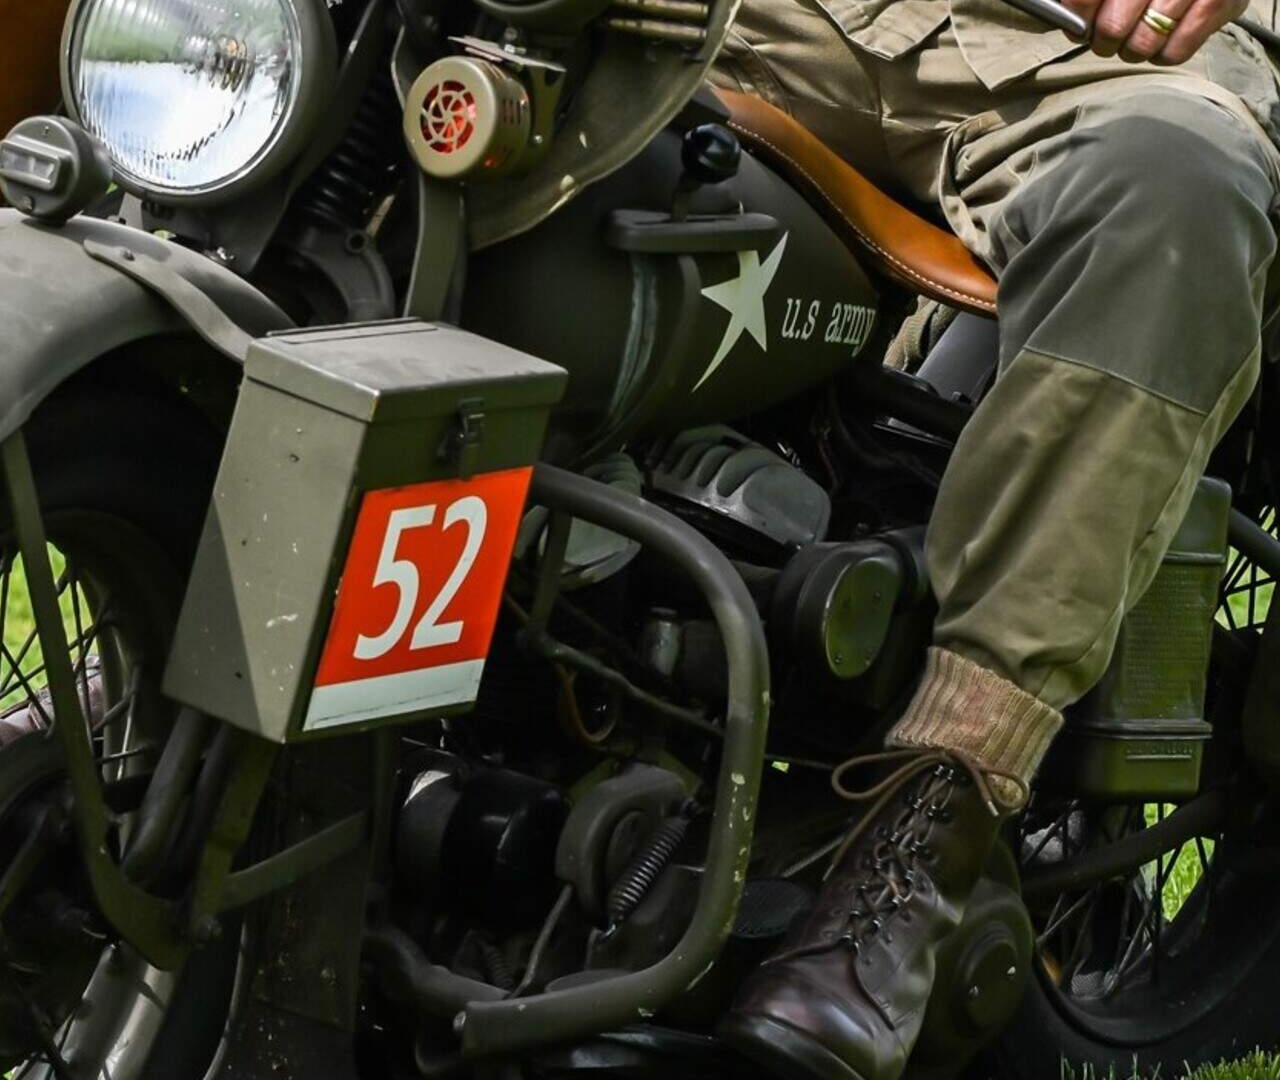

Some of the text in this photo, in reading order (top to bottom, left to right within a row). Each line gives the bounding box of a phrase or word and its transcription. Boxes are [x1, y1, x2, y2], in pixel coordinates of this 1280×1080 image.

[781, 297, 876, 358] u.s army
[353, 495, 488, 661] 52
